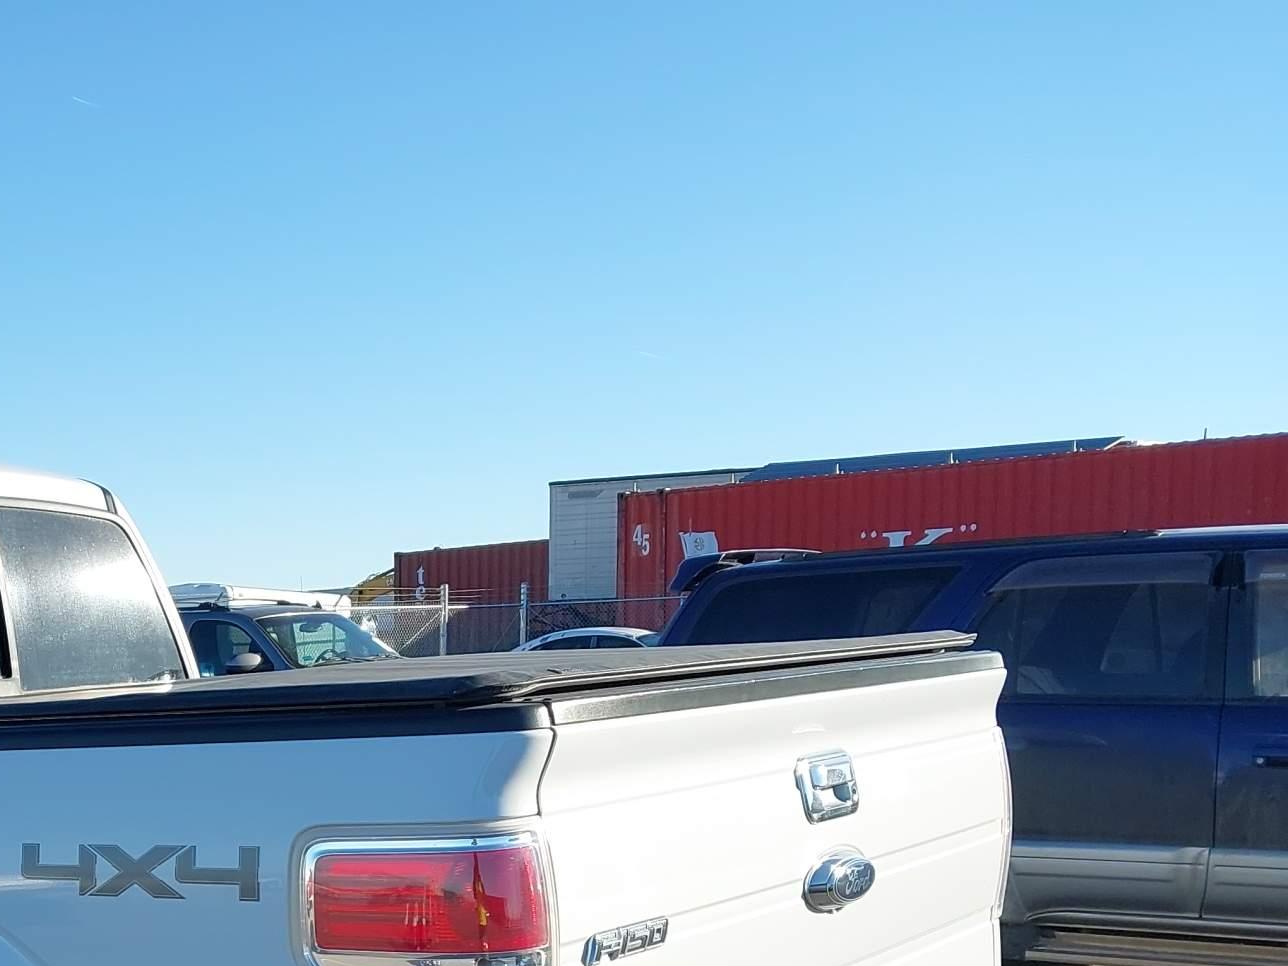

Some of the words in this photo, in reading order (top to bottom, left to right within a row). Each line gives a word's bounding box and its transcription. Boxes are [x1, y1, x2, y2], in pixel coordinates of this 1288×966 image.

[632, 523, 650, 556] 45
[21, 843, 260, 901] 4X4
[843, 863, 872, 896] Ford
